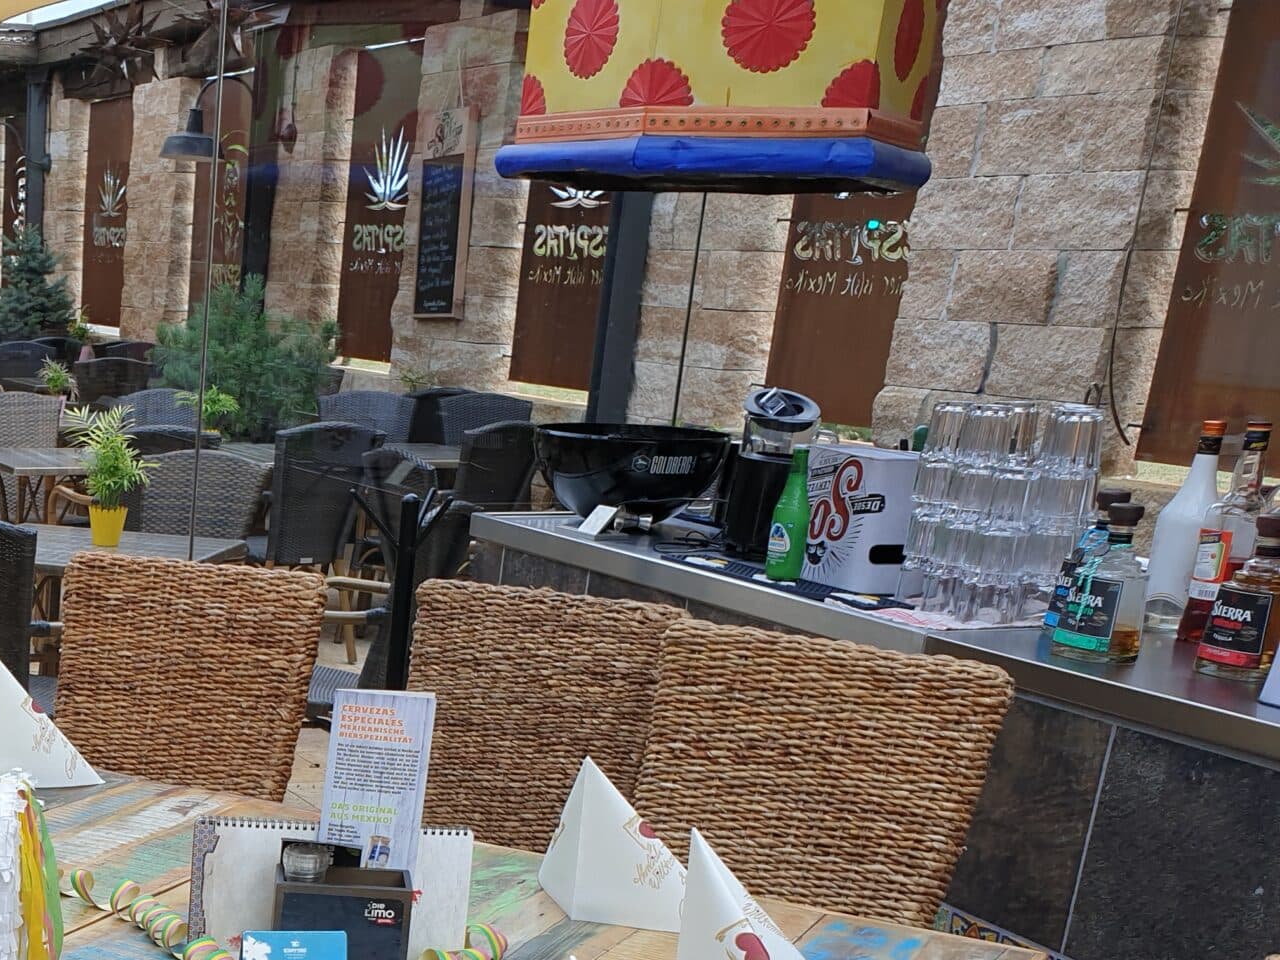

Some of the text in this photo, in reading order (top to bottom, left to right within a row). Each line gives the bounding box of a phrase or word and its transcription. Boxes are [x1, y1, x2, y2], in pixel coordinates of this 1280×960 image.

[649, 455, 694, 474] GOLDBERG
[1211, 600, 1252, 622] SIERRA
[341, 704, 396, 716] CERVEZAS
[340, 714, 404, 727] ESPECIALES
[339, 723, 405, 735] MEXIKANISCHE
[338, 732, 413, 744] BIERSPEZIALITÄT
[330, 802, 399, 816] DAS ORIGINAL
[329, 812, 393, 825] AUS MEXIKO!
